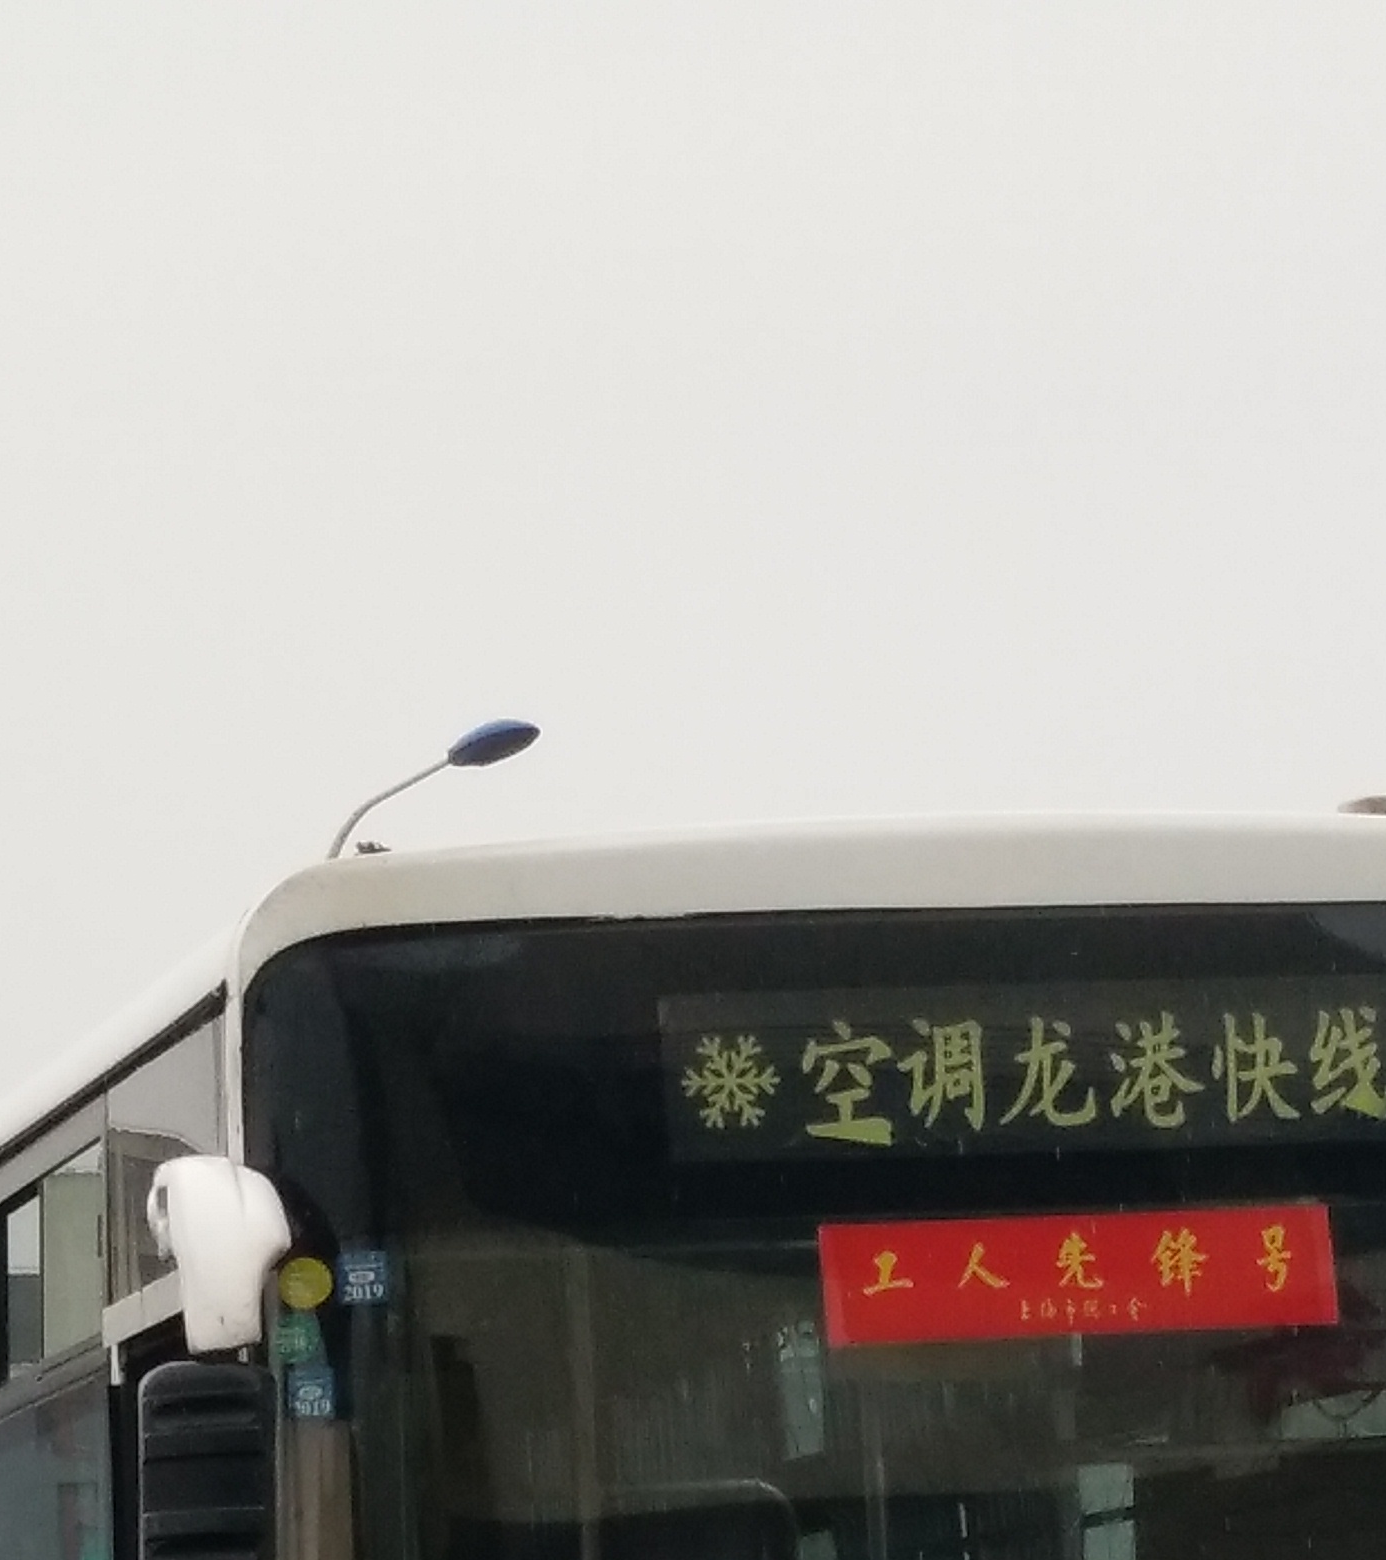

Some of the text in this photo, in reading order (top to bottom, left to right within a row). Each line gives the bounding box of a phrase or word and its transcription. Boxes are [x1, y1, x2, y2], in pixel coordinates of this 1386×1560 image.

[863, 1224, 1293, 1296] 工人先锋号
